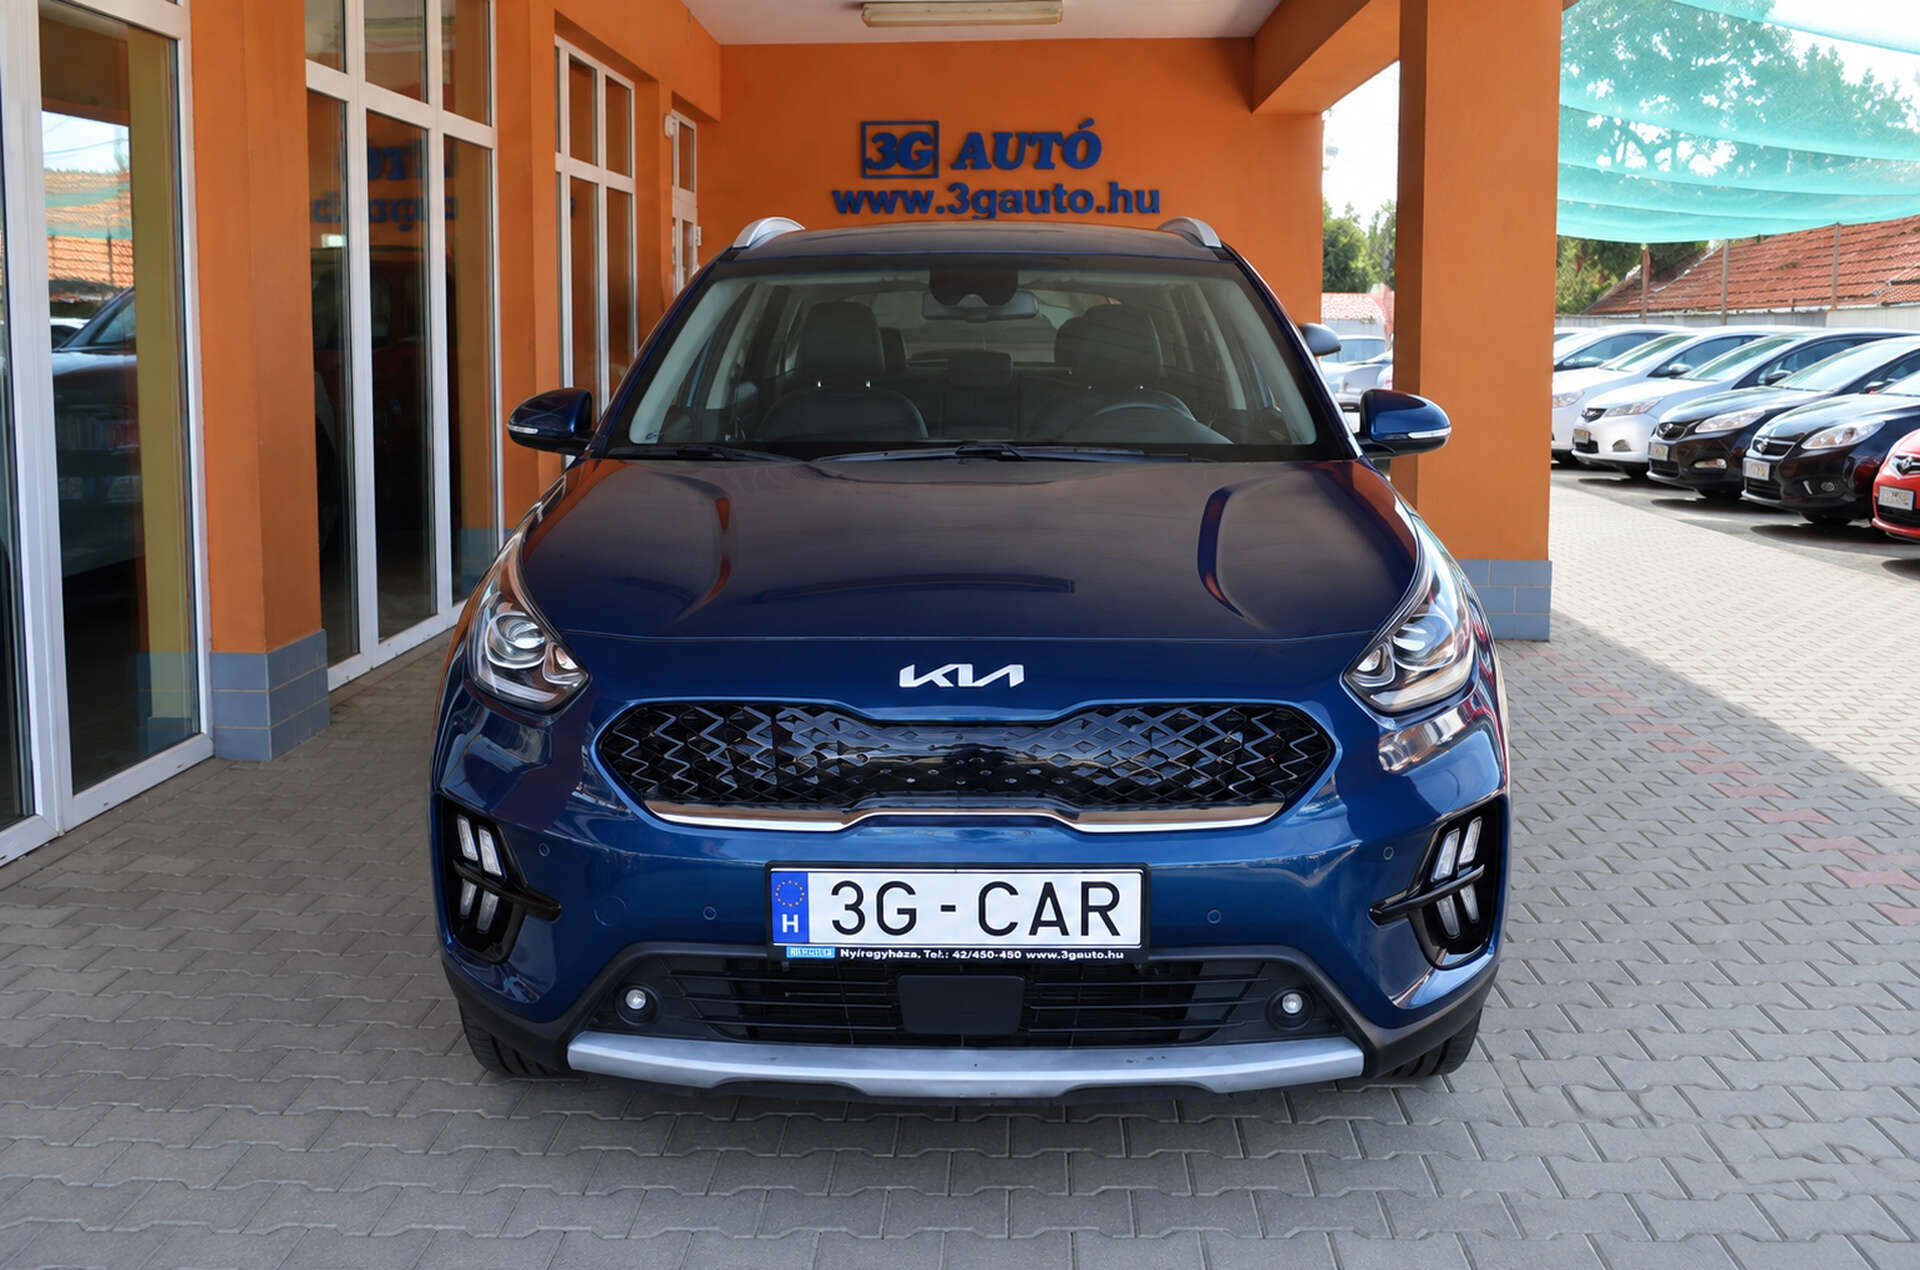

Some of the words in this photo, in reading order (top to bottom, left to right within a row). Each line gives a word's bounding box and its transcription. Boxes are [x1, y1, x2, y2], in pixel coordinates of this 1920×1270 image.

[864, 130, 935, 171] 3G
[950, 118, 1103, 171] AUTÓ
[831, 181, 1161, 220] www.3gauto.hu
[899, 663, 1025, 688] KIA
[781, 913, 800, 934] H
[830, 879, 918, 937] 3G
[977, 879, 1122, 937] CAR
[1025, 949, 1125, 961] www.3gauto.hu
